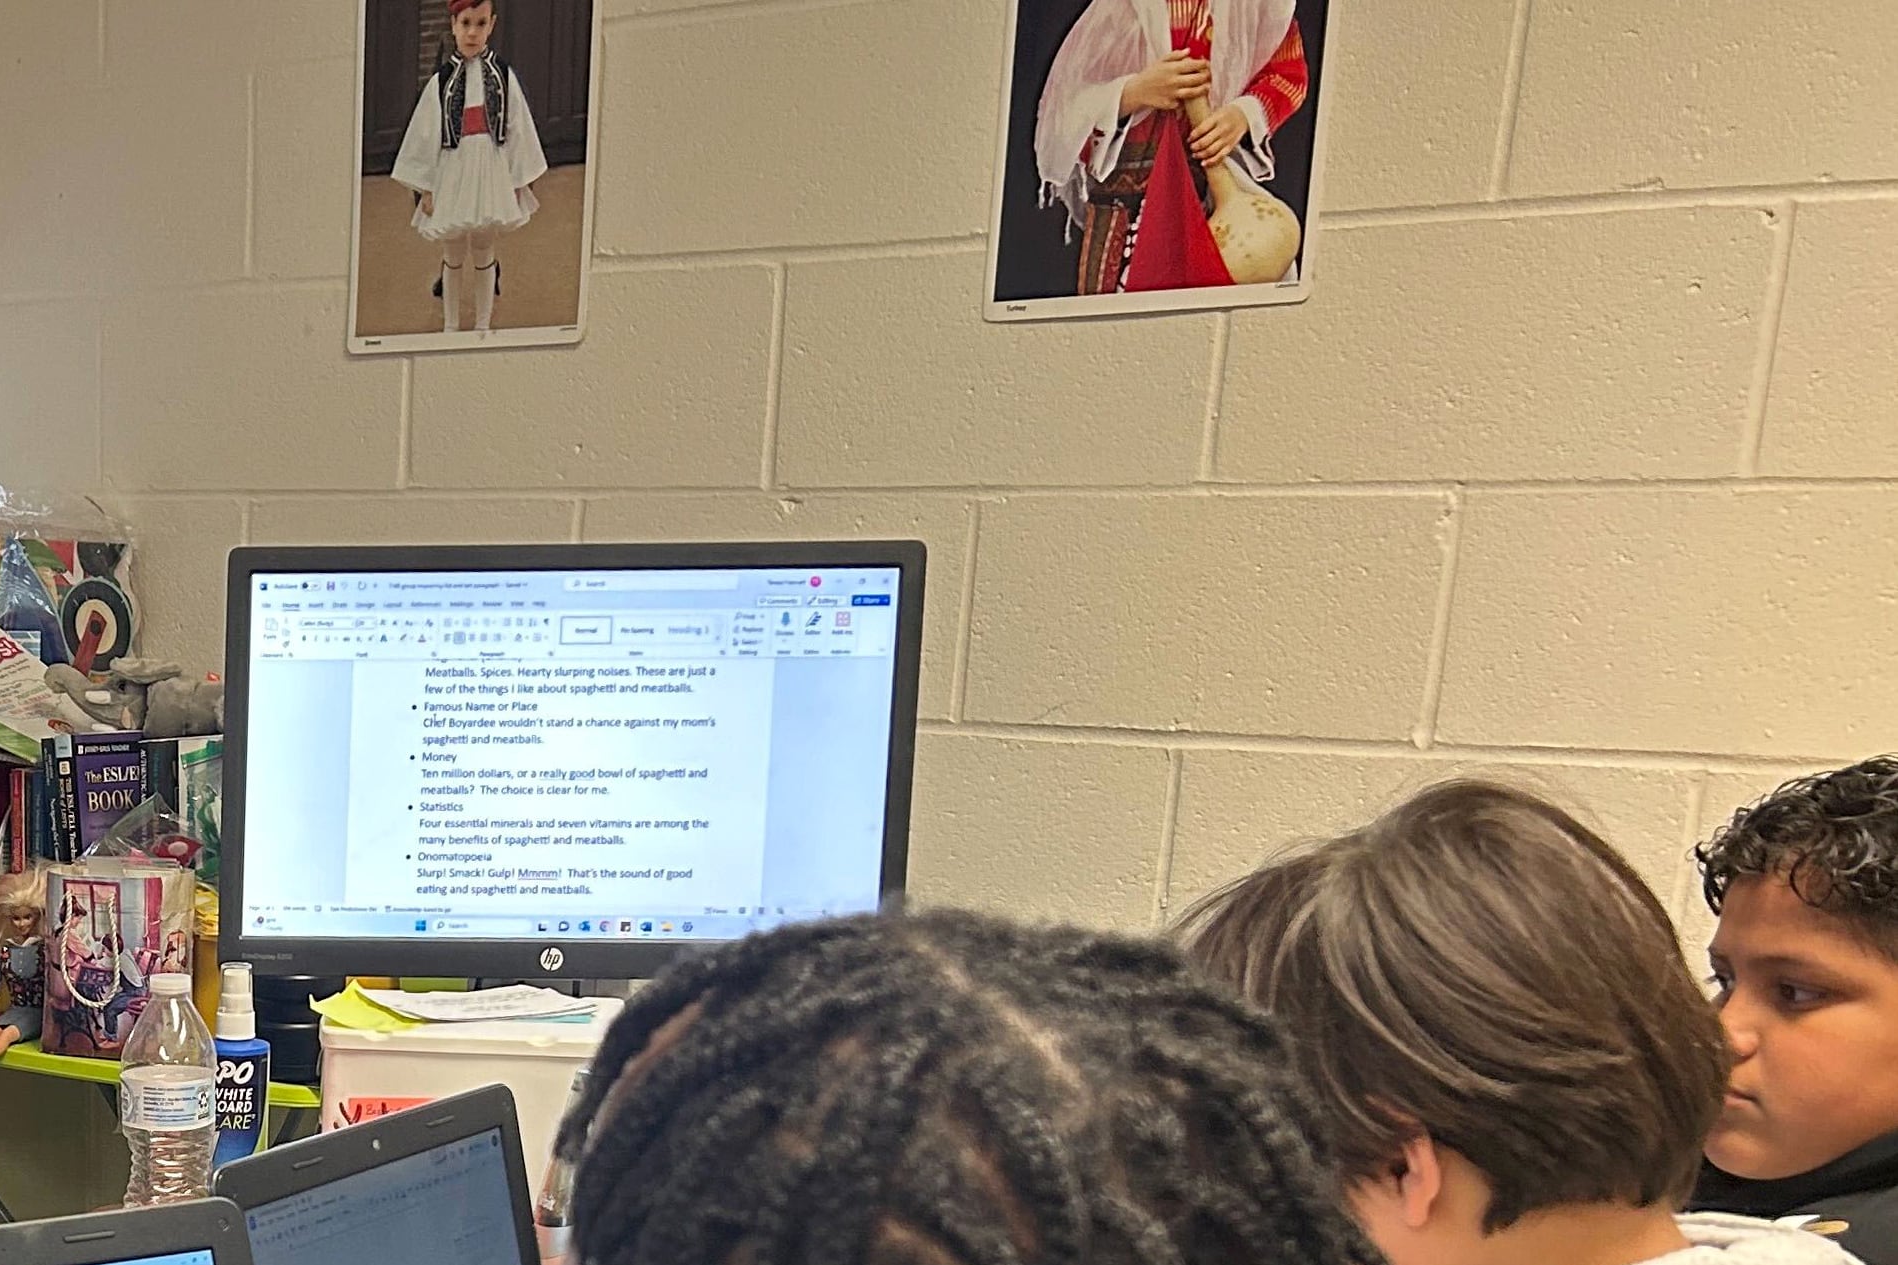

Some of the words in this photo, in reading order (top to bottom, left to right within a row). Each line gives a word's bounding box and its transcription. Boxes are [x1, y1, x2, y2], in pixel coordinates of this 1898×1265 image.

[425, 667, 477, 677] Meatballs.
[480, 668, 513, 678] Spices.
[518, 667, 551, 678] Hearty
[554, 667, 595, 678] slurping
[598, 667, 632, 676] noises.
[636, 666, 665, 676] These
[668, 668, 685, 676] are
[687, 666, 706, 678] just
[425, 685, 443, 694] few
[446, 684, 456, 694] of
[459, 684, 475, 694] the
[478, 684, 508, 696] things
[518, 684, 534, 693] like
[537, 684, 567, 693] about
[570, 684, 616, 695] spaghetti
[619, 683, 638, 692] and
[641, 683, 695, 693] meatballs.
[424, 702, 462, 711] Famous
[466, 702, 495, 711] Name
[512, 702, 537, 711] Place
[423, 718, 446, 728] Chef
[449, 718, 495, 729] Boyardee
[547, 718, 573, 727] stand
[585, 718, 621, 727] chance
[624, 718, 660, 729] against
[663, 719, 678, 729] my
[423, 735, 468, 746] spaghetti
[471, 735, 490, 744] and
[493, 735, 544, 744] meatballs.
[422, 752, 457, 763] Money
[85, 770, 102, 783] The
[422, 769, 438, 778] Ten
[441, 769, 475, 778] million
[478, 769, 514, 779] dollars,
[540, 769, 567, 779] really
[569, 769, 595, 780] good
[598, 768, 622, 778] bowl
[626, 768, 637, 778] of
[639, 768, 685, 780] spaghetti
[688, 768, 708, 778] and
[421, 785, 475, 795] meatballs?
[480, 785, 498, 794] The
[501, 785, 533, 794] choice
[537, 785, 543, 794] is
[547, 785, 571, 794] clear
[575, 785, 588, 794] for
[87, 789, 135, 812] BOOK
[420, 802, 464, 812] Statistics
[419, 819, 441, 828] Four
[444, 819, 488, 828] essential
[491, 819, 533, 828] minerals
[536, 819, 555, 828] and
[590, 819, 632, 828] vitamins
[654, 821, 689, 830] among
[692, 819, 709, 828] the
[419, 837, 445, 846] many
[449, 835, 488, 844] benefits
[492, 835, 502, 844] of
[505, 835, 550, 847] spaghetti
[553, 836, 572, 844] and
[575, 836, 626, 845] meatballs.
[418, 852, 492, 863] Onomatopoeia
[417, 869, 446, 879] Slurp!
[449, 868, 484, 877] Smack!
[488, 868, 515, 879] Gulp!
[600, 869, 617, 878] the
[620, 869, 651, 878] sound
[654, 869, 665, 878] of
[666, 869, 693, 880] good
[417, 885, 447, 896] eating
[450, 885, 468, 894] and
[471, 885, 516, 896] spaghetti
[520, 885, 538, 894] and
[543, 885, 593, 894] meatballs.
[215, 1100, 253, 1113] OARD
